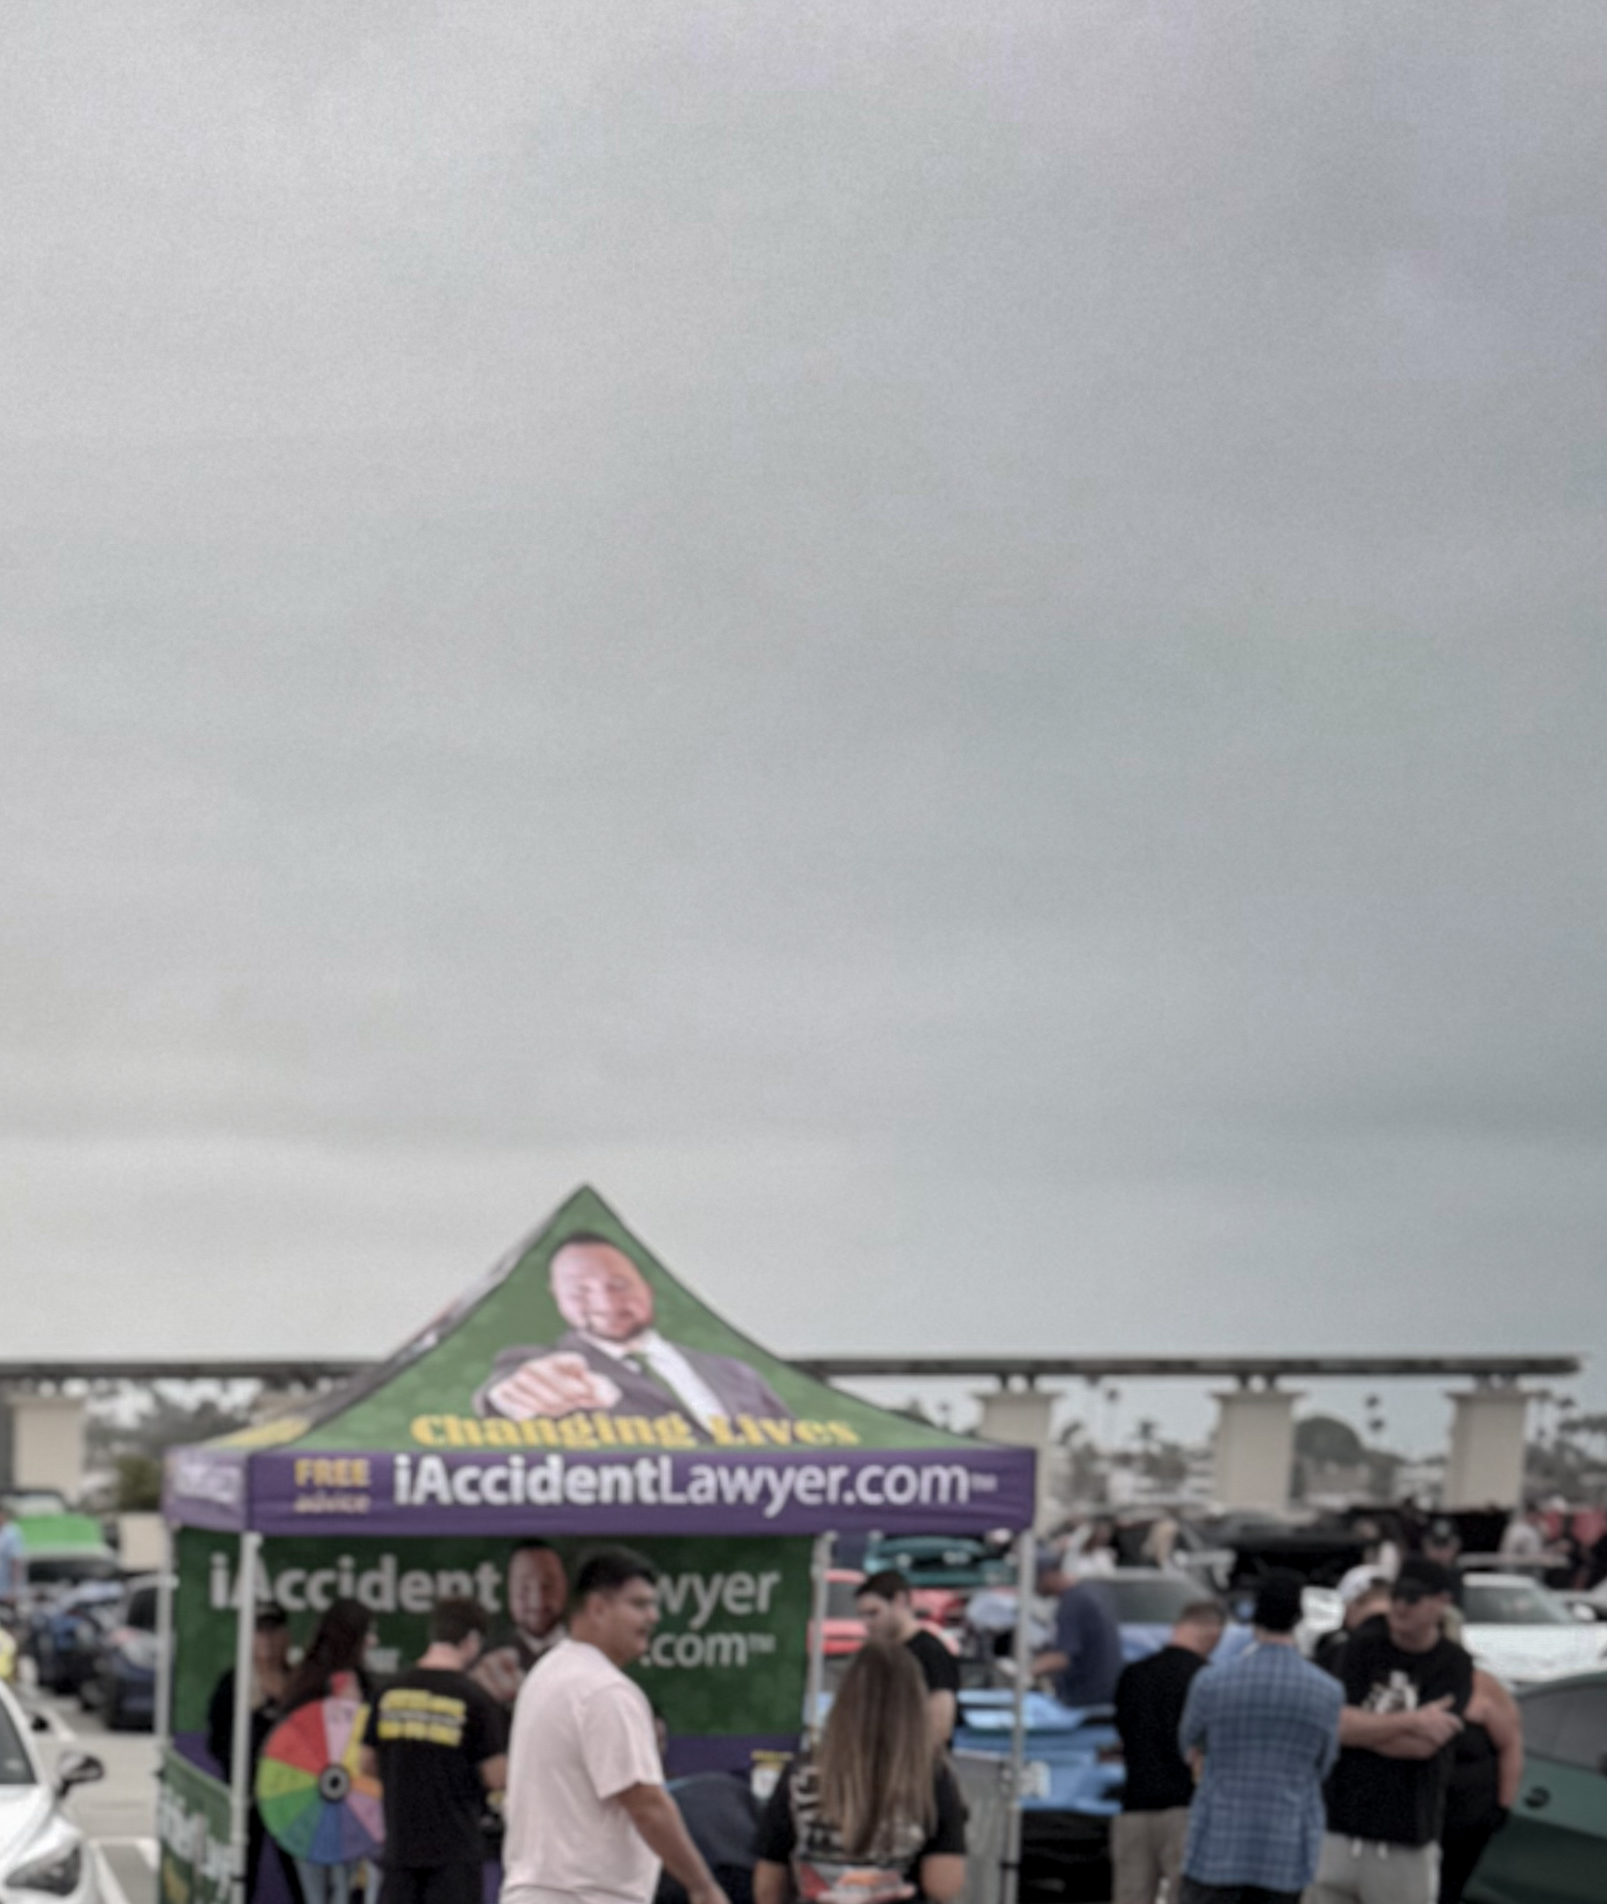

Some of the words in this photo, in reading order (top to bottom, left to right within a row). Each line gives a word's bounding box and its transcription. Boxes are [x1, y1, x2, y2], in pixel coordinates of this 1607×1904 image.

[410, 1412, 695, 1448] Changing
[710, 1415, 861, 1446] Lives
[295, 1458, 370, 1487] FREE
